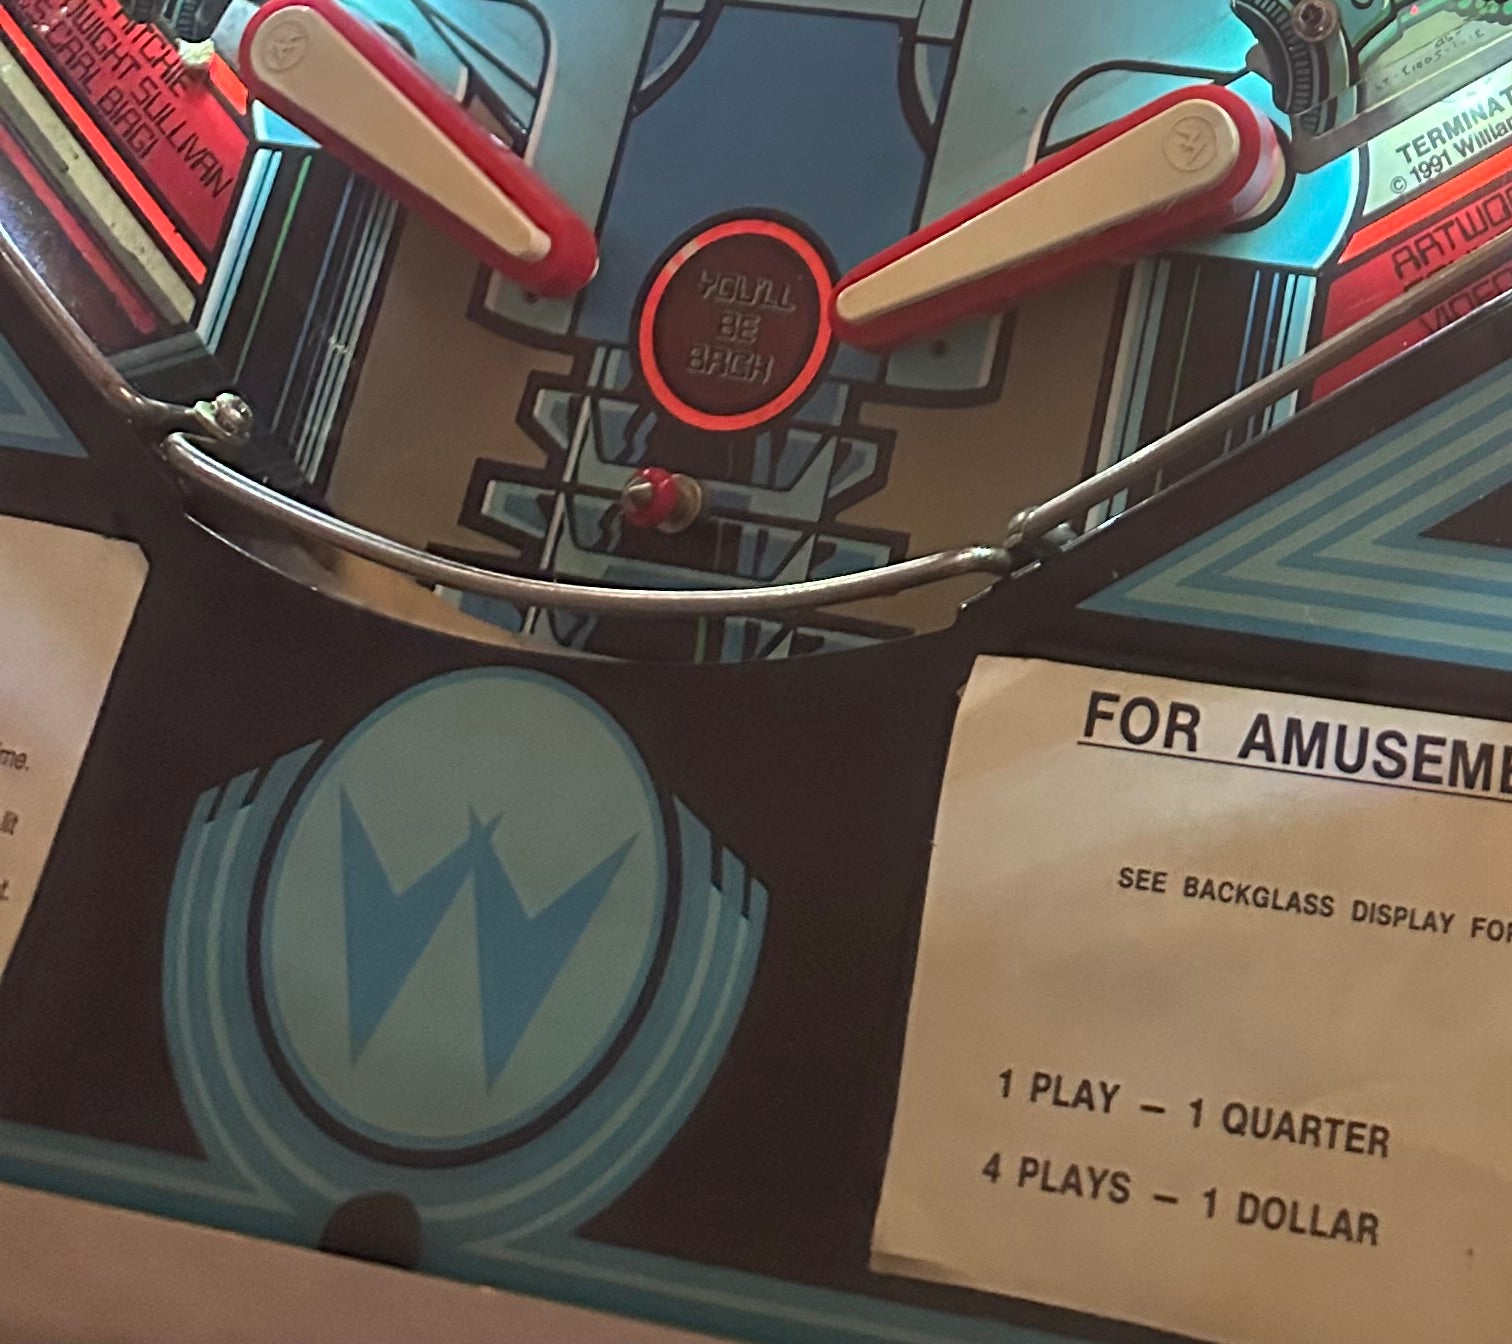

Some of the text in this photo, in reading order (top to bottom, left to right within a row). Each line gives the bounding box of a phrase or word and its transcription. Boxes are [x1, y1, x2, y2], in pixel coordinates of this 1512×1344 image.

[41, 18, 112, 98] CARL
[93, 85, 162, 162] BIAGI
[126, 73, 229, 193] SULLIVAN
[1409, 152, 1452, 187] 1991
[687, 346, 775, 385] BACK
[1082, 690, 1202, 756] FOR
[1117, 865, 1169, 896] SEE
[1183, 873, 1336, 920] BACKGLASS
[1350, 898, 1456, 937] DISPLAY
[998, 1068, 1014, 1100] 1
[1029, 1071, 1122, 1116] PLAY
[1187, 1099, 1204, 1130] 1
[1222, 1101, 1393, 1160] QUARTER
[980, 1151, 1002, 1186] 4
[1016, 1157, 1133, 1208] PLAYS
[1201, 1188, 1218, 1221] 1
[1236, 1190, 1382, 1249] DOLLAR
